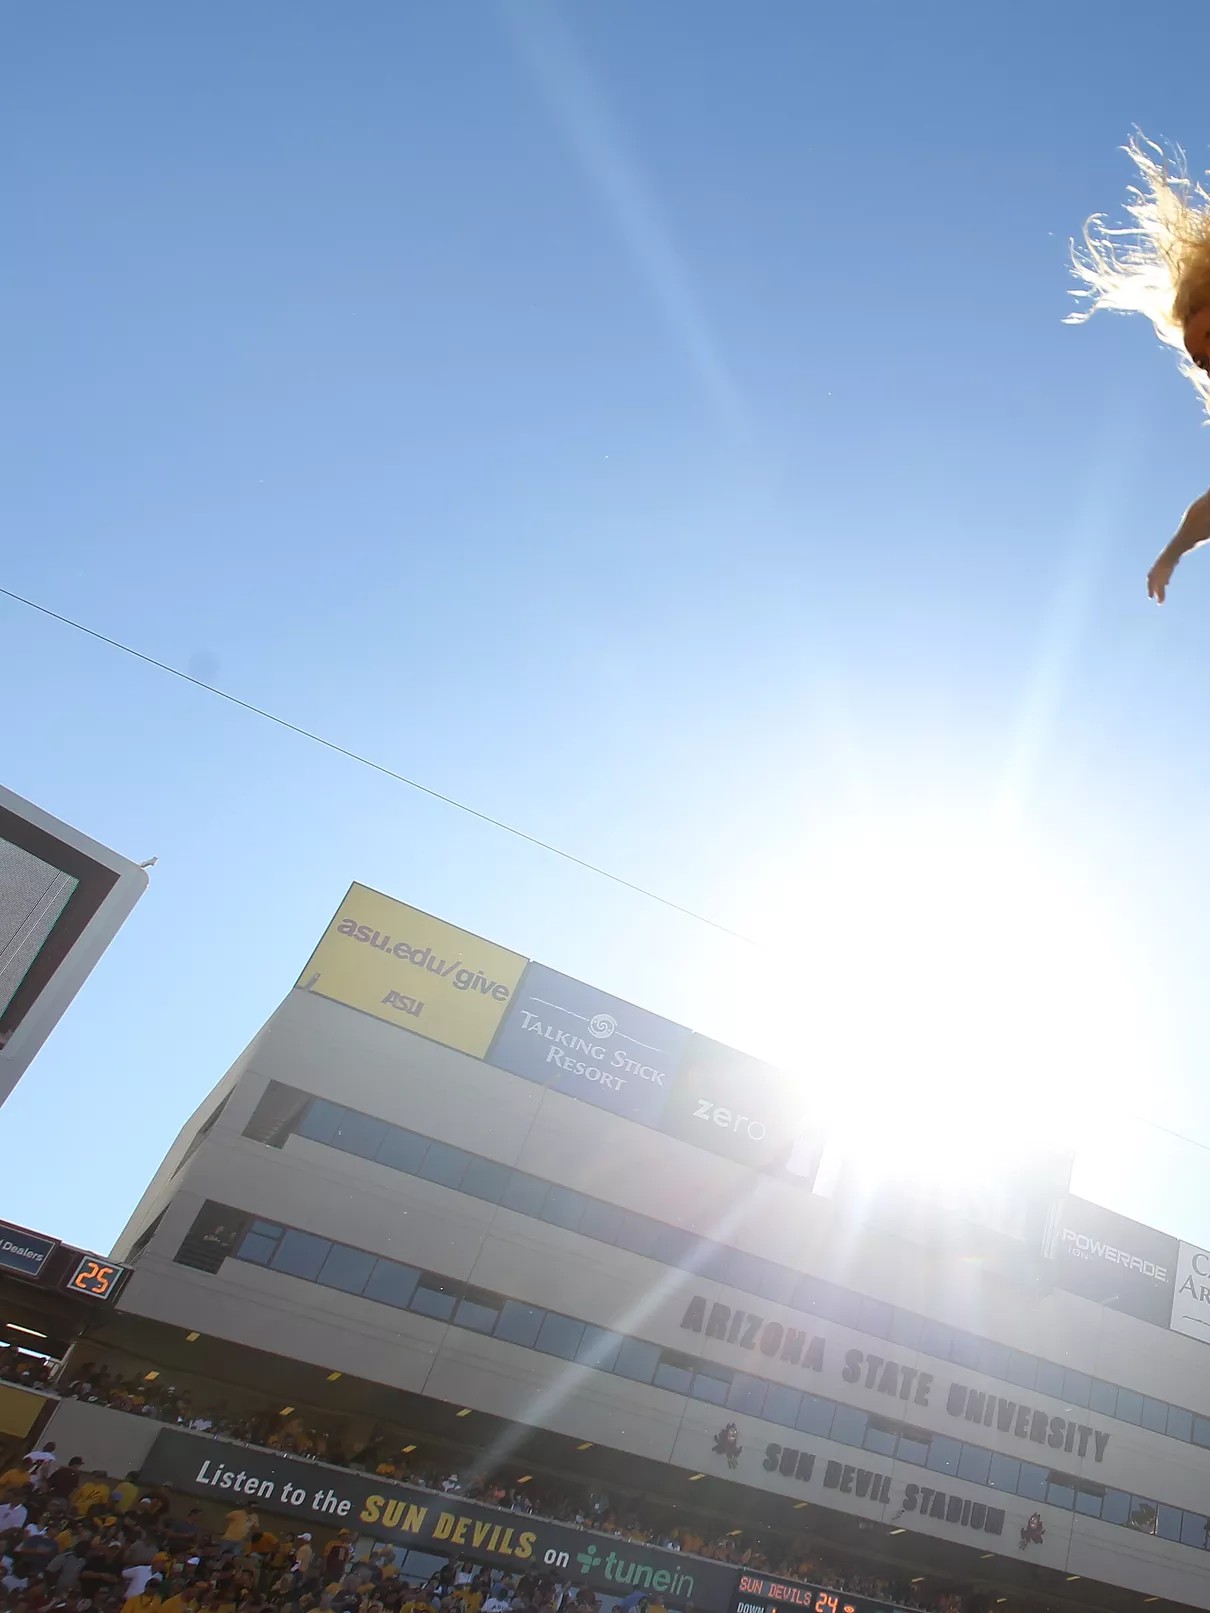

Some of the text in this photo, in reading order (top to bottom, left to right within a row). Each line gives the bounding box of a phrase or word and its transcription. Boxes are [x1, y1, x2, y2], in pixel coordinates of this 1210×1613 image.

[337, 918, 509, 1001] asu.edu/give
[381, 989, 424, 1017] ASU
[546, 1045, 627, 1091] RESORT
[693, 1098, 767, 1141] zero
[2, 1241, 44, 1262] Dealers
[75, 1262, 113, 1293] 25
[680, 1295, 1111, 1463] ARIZONA STATE UNIVERSITY
[763, 1443, 1005, 1535] SUN DEVIL STADIUM
[196, 1460, 695, 1599] Listen to the SUN DEVILS on tunein
[739, 1576, 839, 1613] SUN DEVILS 24
